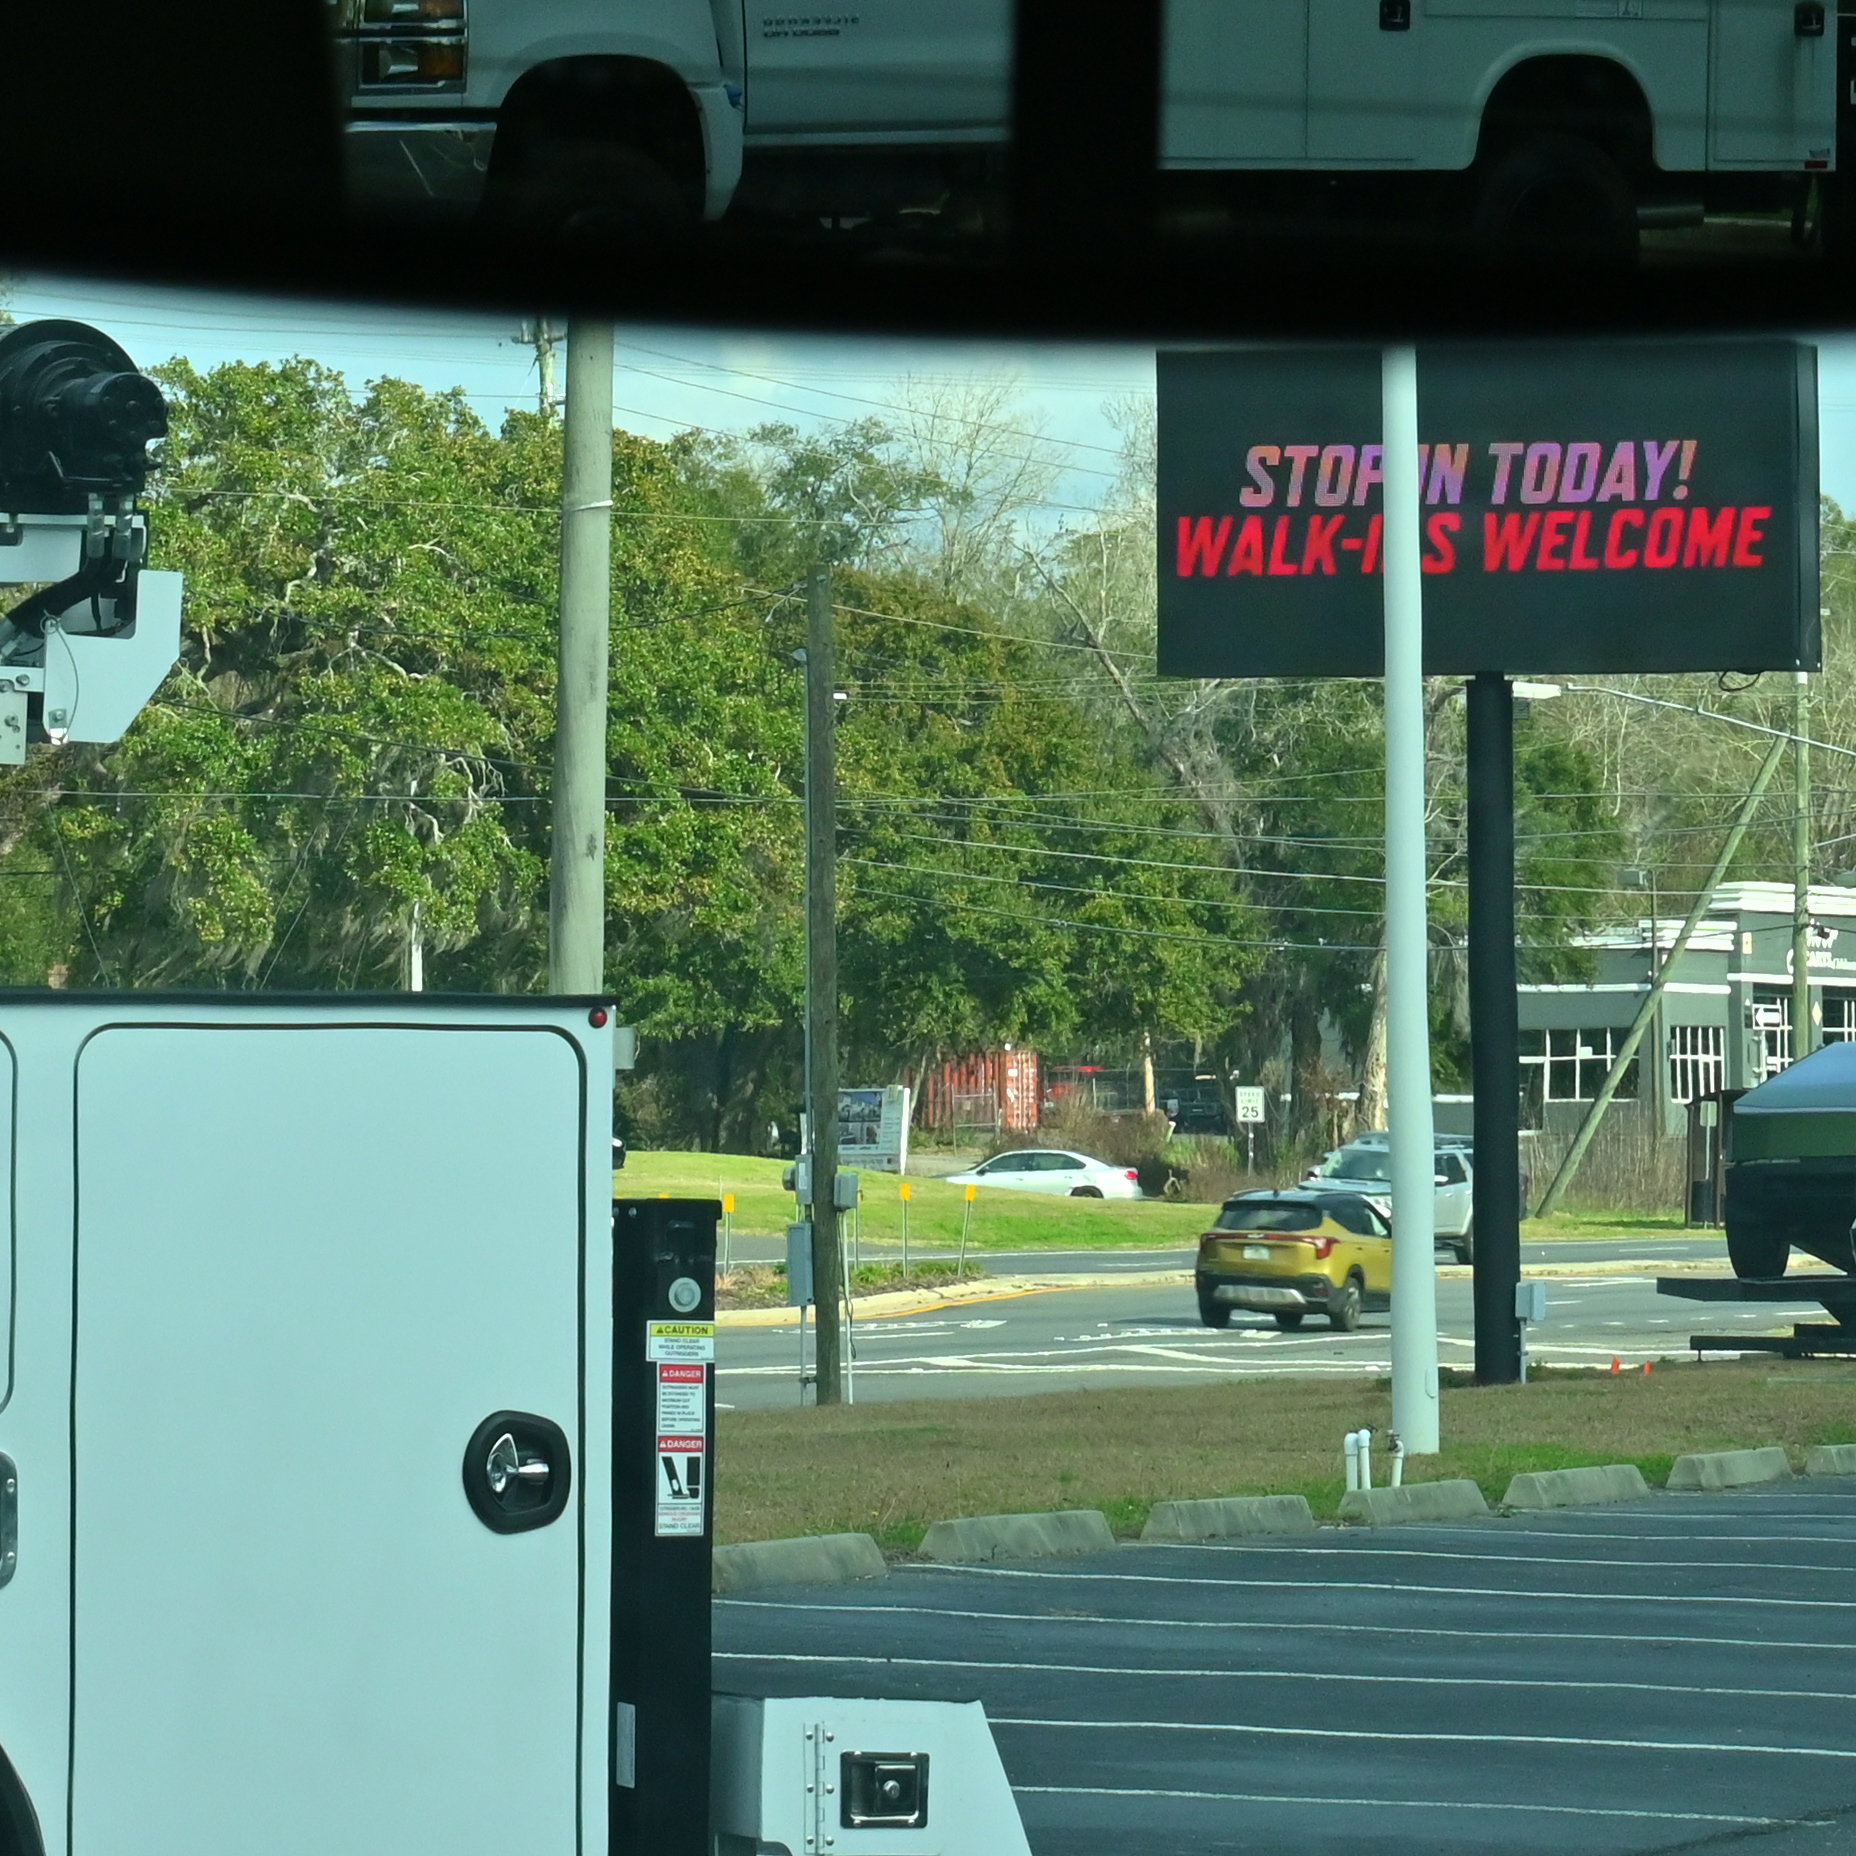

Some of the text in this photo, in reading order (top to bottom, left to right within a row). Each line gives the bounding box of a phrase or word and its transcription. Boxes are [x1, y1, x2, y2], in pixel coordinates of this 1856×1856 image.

[1239, 444, 1383, 507] STOP
[1488, 440, 1698, 505] TODAY!
[1176, 505, 1772, 577] WALK-IS WELCOME
[1242, 1105, 1259, 1119] 25
[664, 1325, 709, 1335] CAUTION
[668, 1369, 702, 1378] DANGER
[667, 1439, 703, 1449] DANGER
